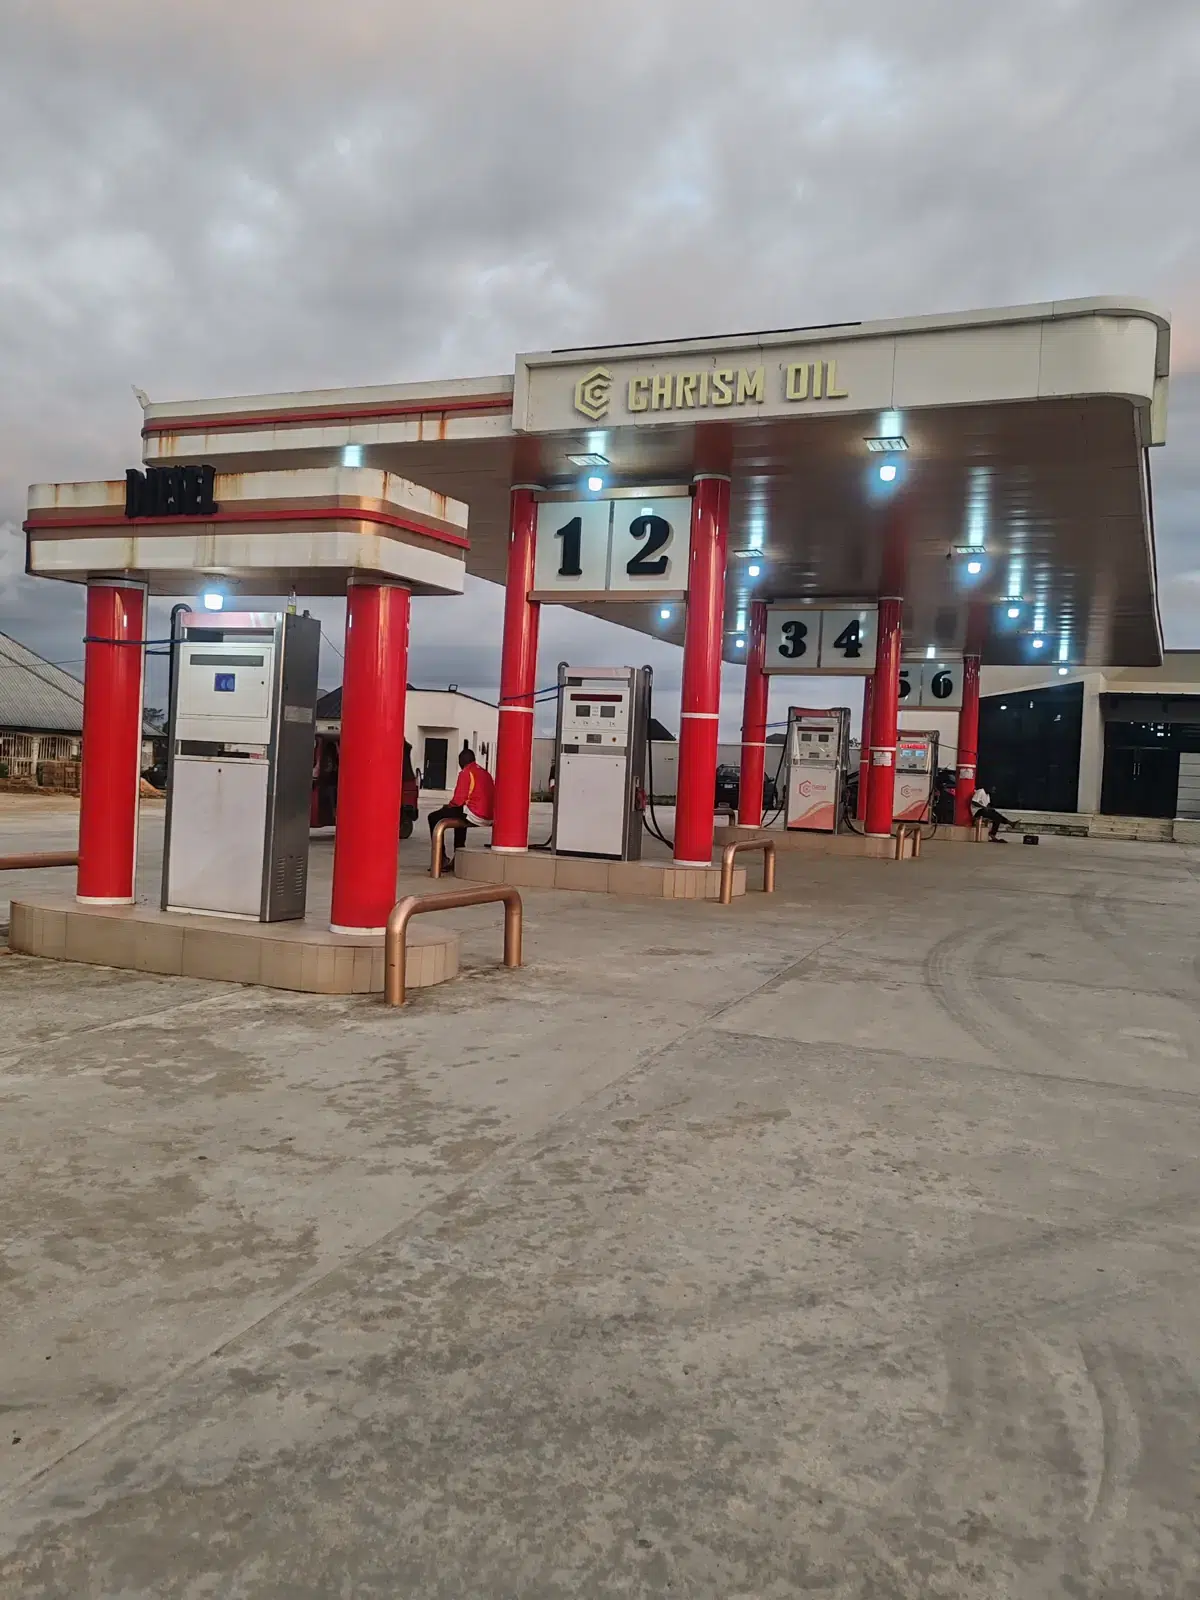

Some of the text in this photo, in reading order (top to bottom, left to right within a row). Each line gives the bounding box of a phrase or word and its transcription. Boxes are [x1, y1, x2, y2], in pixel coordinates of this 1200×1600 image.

[628, 360, 849, 412] CHRISM OIL
[556, 515, 671, 576] 1 2
[778, 619, 863, 658] 3 4
[931, 670, 953, 699] 6
